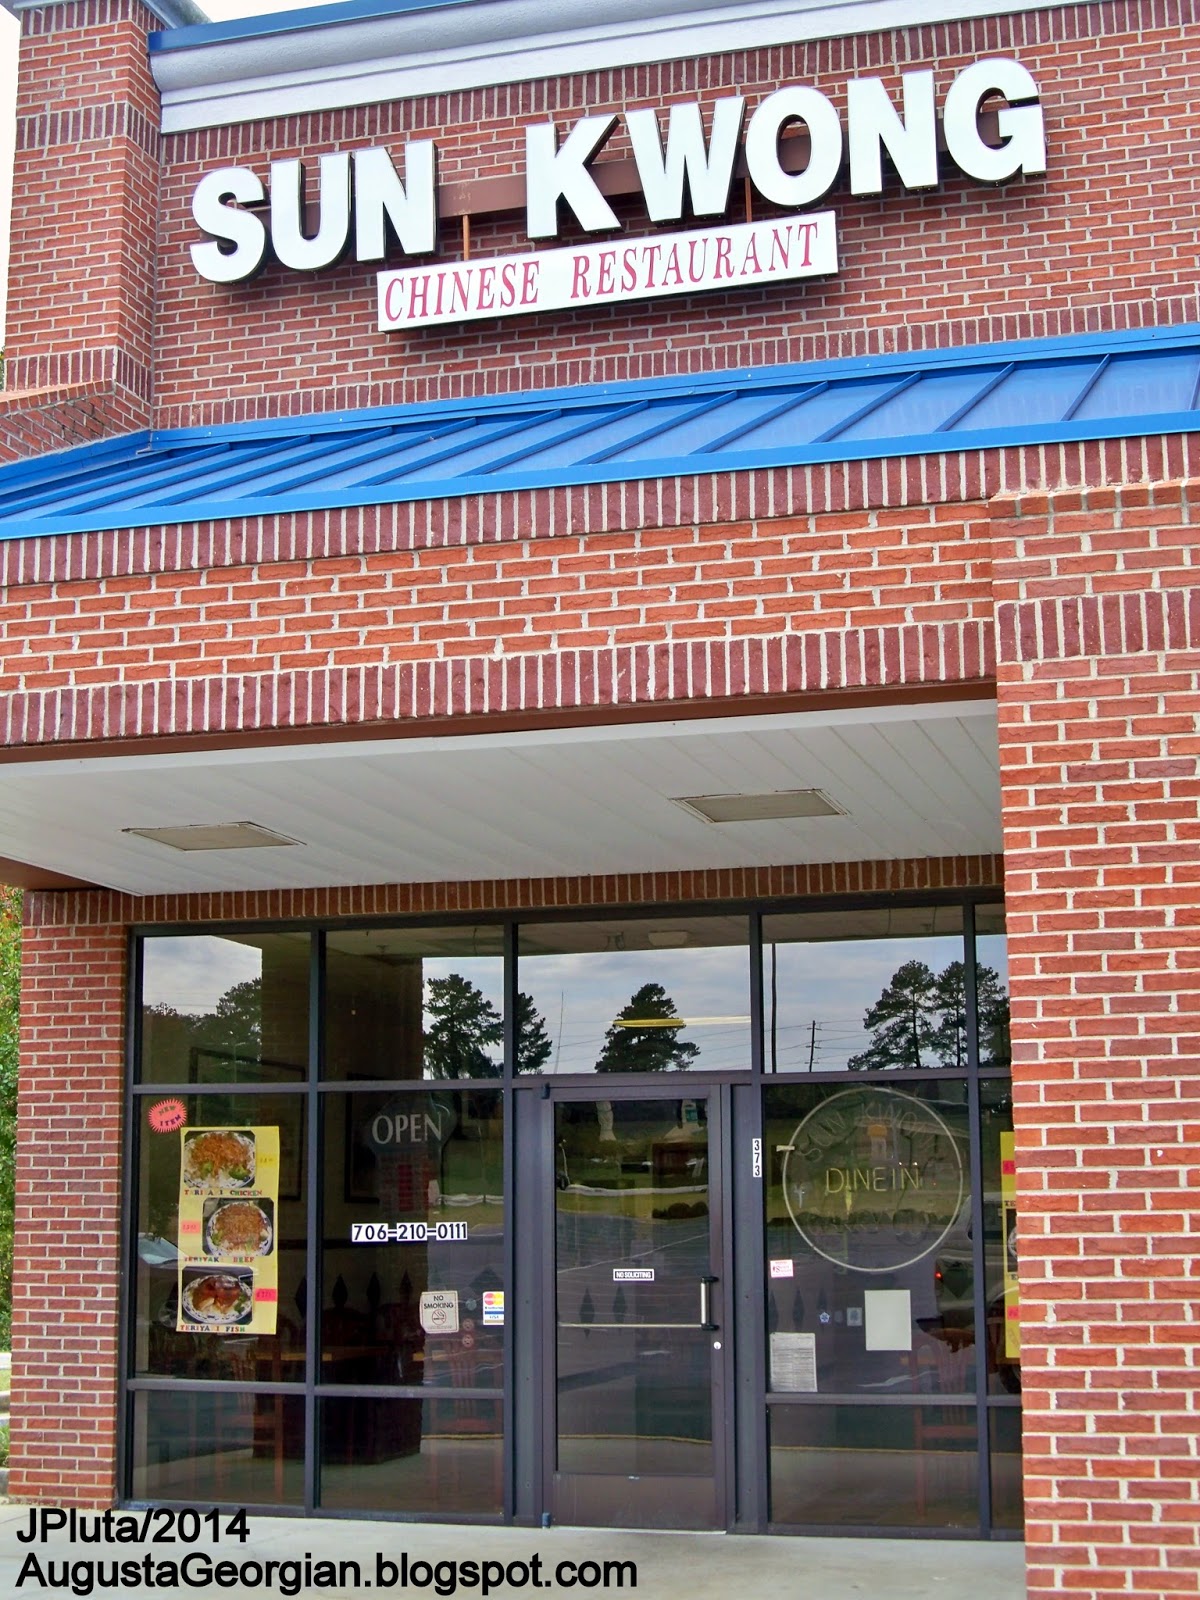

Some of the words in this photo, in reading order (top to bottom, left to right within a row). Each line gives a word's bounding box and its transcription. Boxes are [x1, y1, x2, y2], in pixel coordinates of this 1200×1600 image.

[189, 139, 437, 283] SUN
[525, 57, 1047, 240] KWONG
[384, 260, 540, 322] CHINESE
[570, 222, 819, 299] RESTAURANT
[158, 1105, 176, 1116] NEW
[160, 1114, 181, 1126] ITEM
[372, 1113, 442, 1144] OPEN
[353, 1223, 467, 1241] 706-210-0111
[423, 1301, 454, 1310] SMOKING
[433, 1294, 444, 1302] NO
